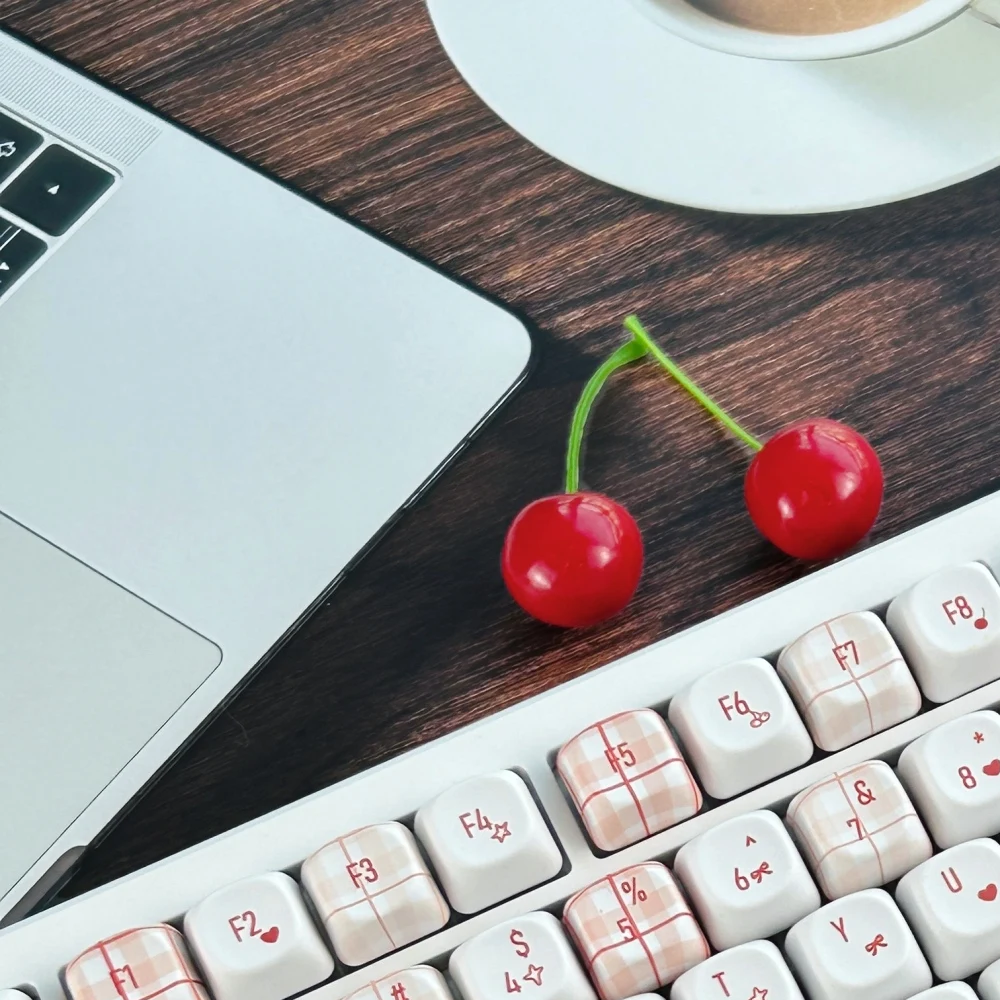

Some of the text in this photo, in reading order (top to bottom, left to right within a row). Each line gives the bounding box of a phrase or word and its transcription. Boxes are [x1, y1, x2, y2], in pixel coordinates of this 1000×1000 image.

[942, 596, 973, 625] F8
[833, 641, 860, 670] F7
[719, 692, 750, 720] F6
[604, 743, 636, 772] F5
[958, 767, 977, 789] 8
[854, 781, 876, 805] &
[459, 809, 492, 838] F4
[846, 819, 864, 840] 7
[346, 858, 378, 887] F3
[734, 868, 750, 890] 6
[941, 867, 962, 893] U
[621, 878, 647, 905] %
[229, 911, 261, 941] F2
[617, 918, 634, 941] 5
[830, 918, 848, 942] Y
[510, 930, 529, 957] $
[109, 965, 139, 995] F1
[505, 972, 521, 993] 4
[712, 972, 730, 996] T
